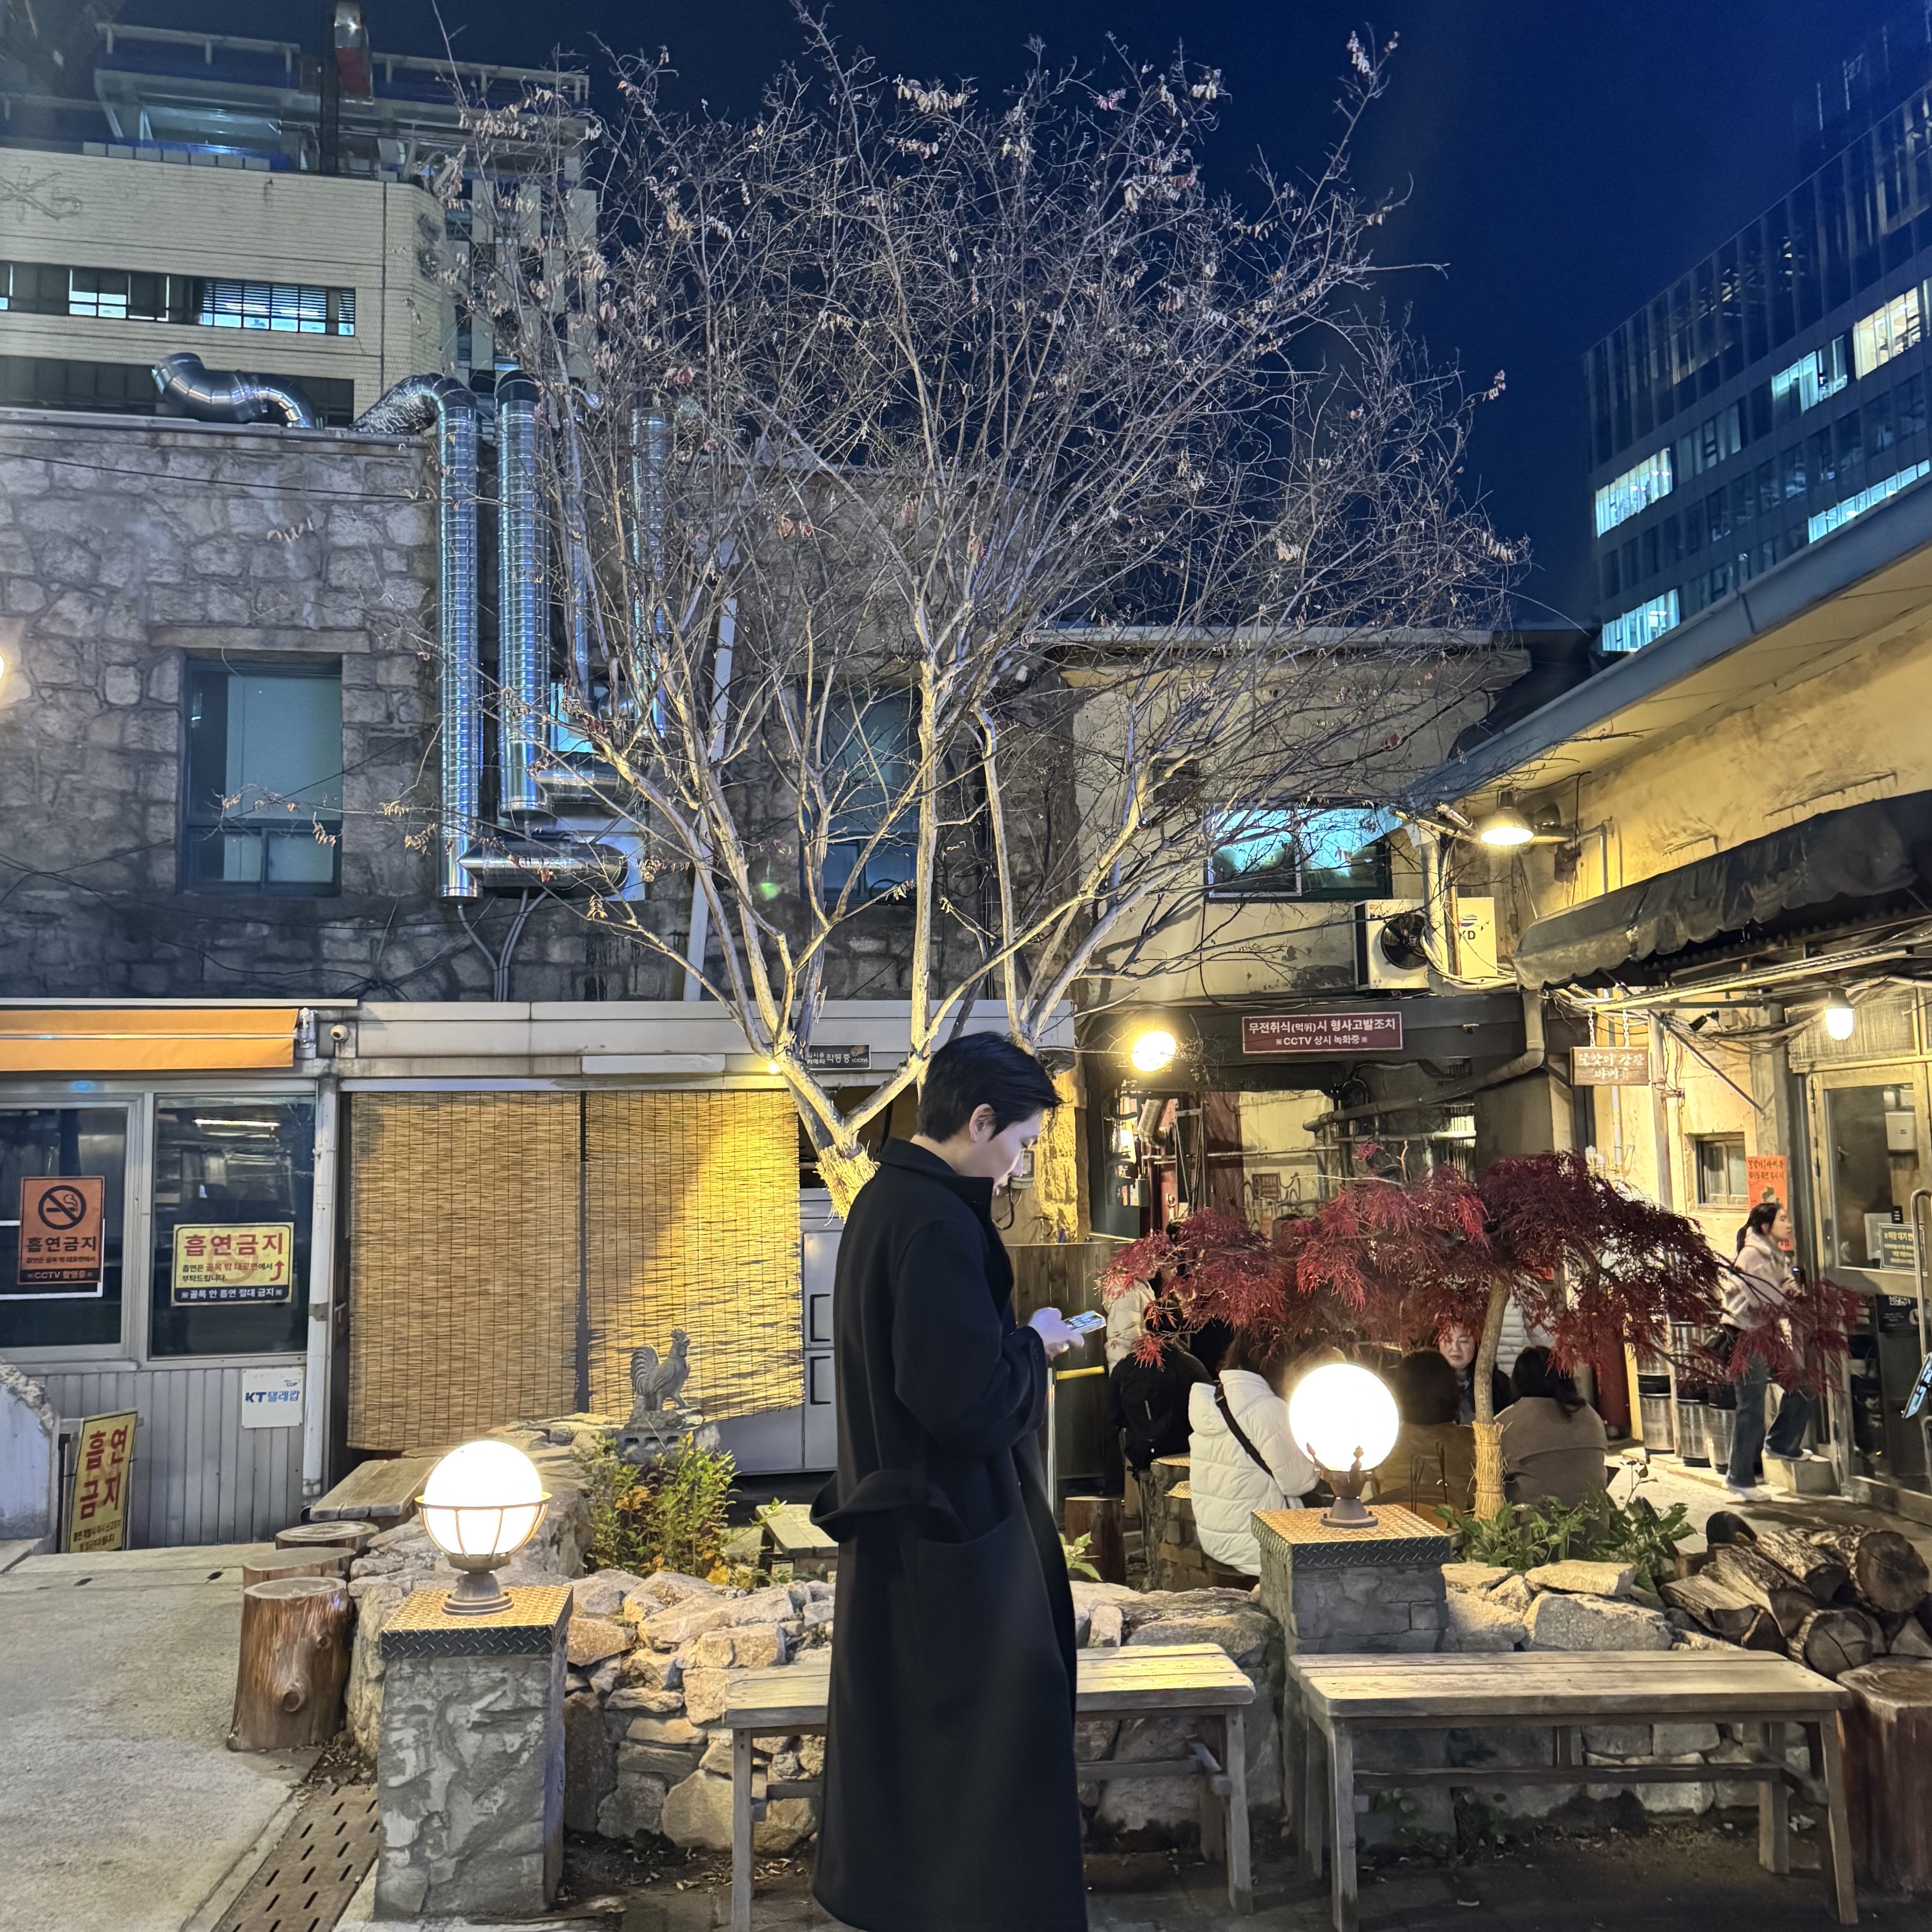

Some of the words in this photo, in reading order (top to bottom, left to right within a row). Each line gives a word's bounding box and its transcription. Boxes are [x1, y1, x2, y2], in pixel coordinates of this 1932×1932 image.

[1331, 1018, 1395, 1032] 형사고발조치
[1283, 1037, 1312, 1046] CCTV
[1314, 1036, 1331, 1045] 상시
[1333, 1034, 1360, 1045] 녹화중
[826, 1053, 850, 1063] 작동중
[27, 1236, 97, 1253] 흡연금지
[184, 1232, 283, 1257] 흡연금지
[182, 1264, 204, 1272] 흡연은
[206, 1263, 222, 1272] 골목
[225, 1263, 232, 1272] 밖
[234, 1262, 273, 1271] 대로변에서
[190, 1290, 207, 1299] 골목
[209, 1289, 217, 1299] 안
[220, 1289, 236, 1298] 흡연
[239, 1288, 255, 1298] 절대
[258, 1288, 274, 1297] 금지
[86, 1424, 128, 1471] 흡연
[80, 1472, 121, 1520] 금지
